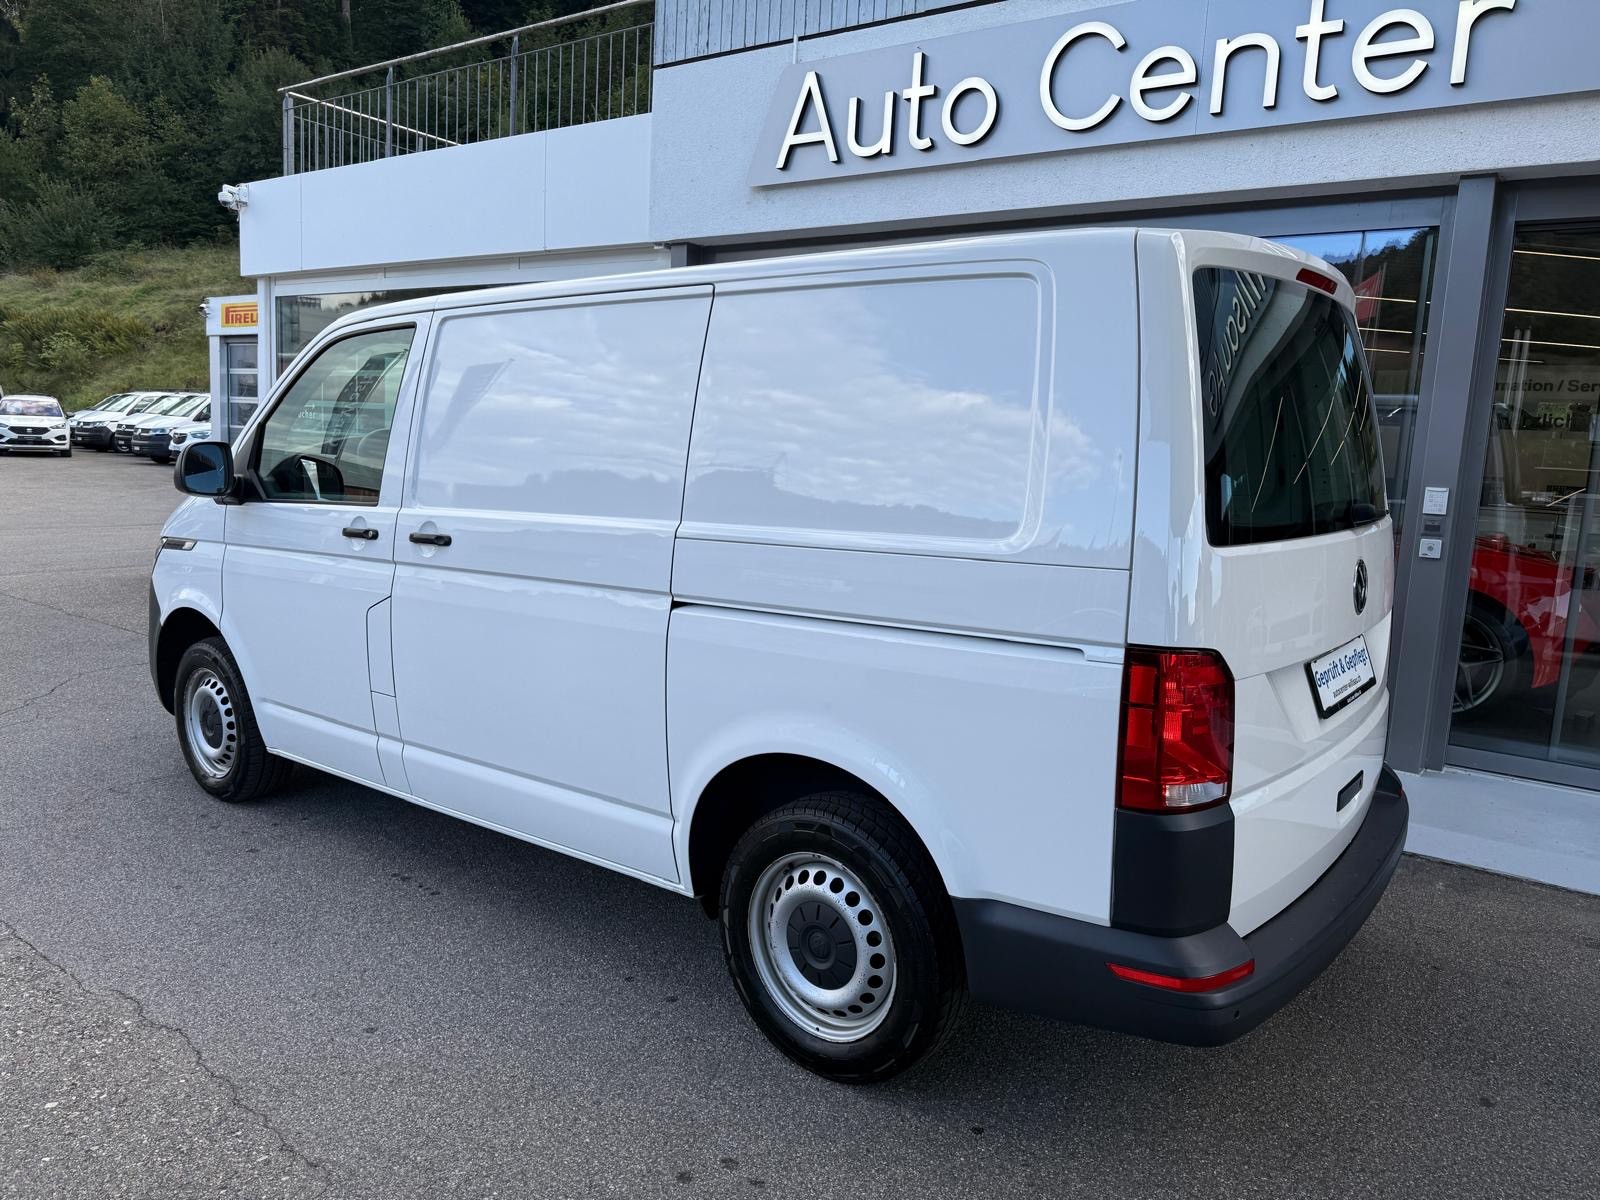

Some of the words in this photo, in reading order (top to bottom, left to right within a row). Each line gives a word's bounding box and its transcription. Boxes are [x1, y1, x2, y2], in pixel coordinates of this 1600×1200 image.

[776, 52, 997, 169] Auto
[1040, 0, 1515, 131] Center
[225, 304, 258, 324] PIREL
[1314, 660, 1341, 688] Geprüft
[1338, 658, 1346, 674] &
[1344, 648, 1368, 672] Gepflegt
